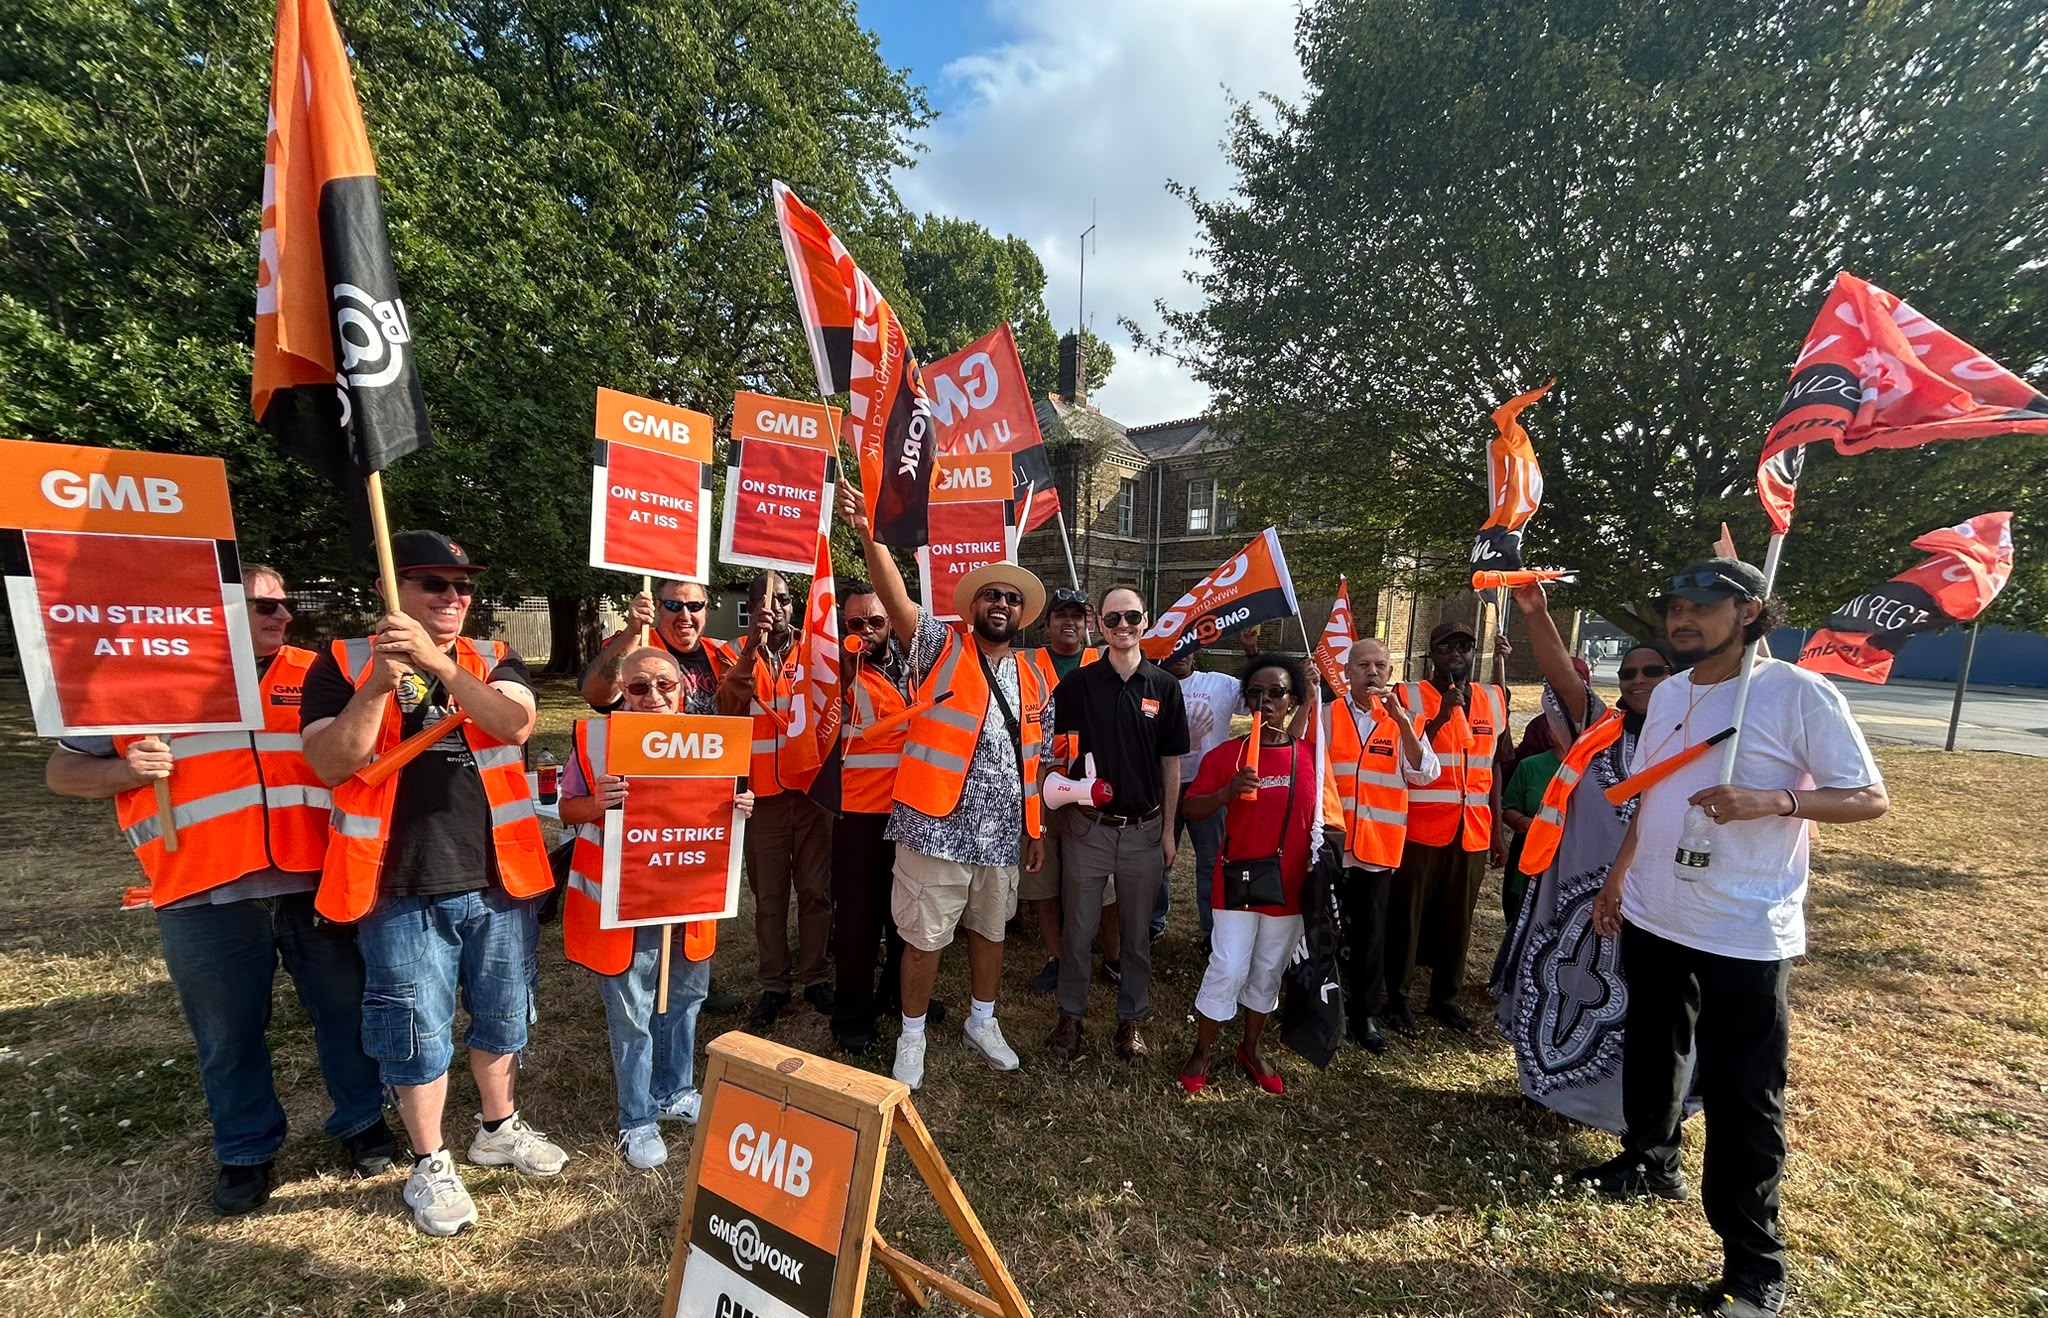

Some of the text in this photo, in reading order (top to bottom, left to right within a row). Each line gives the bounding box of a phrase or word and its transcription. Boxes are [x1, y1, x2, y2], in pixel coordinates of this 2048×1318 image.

[623, 410, 690, 445] GMB
[756, 409, 818, 439] GMB
[41, 470, 183, 514] GMB
[611, 485, 693, 513] ON STRIKE
[742, 479, 817, 502] ON STRIKE
[628, 509, 678, 529] AT ISS
[756, 501, 801, 519] AT ISS
[932, 541, 1001, 556] ON STRIKE
[948, 561, 965, 574] AT
[49, 603, 214, 625] ON STRIKE
[94, 637, 190, 656] AT ISS
[641, 731, 724, 759] GMB
[627, 827, 725, 843] ON STRIKE
[648, 850, 706, 867] AT ISS
[728, 1122, 813, 1198] GMB
